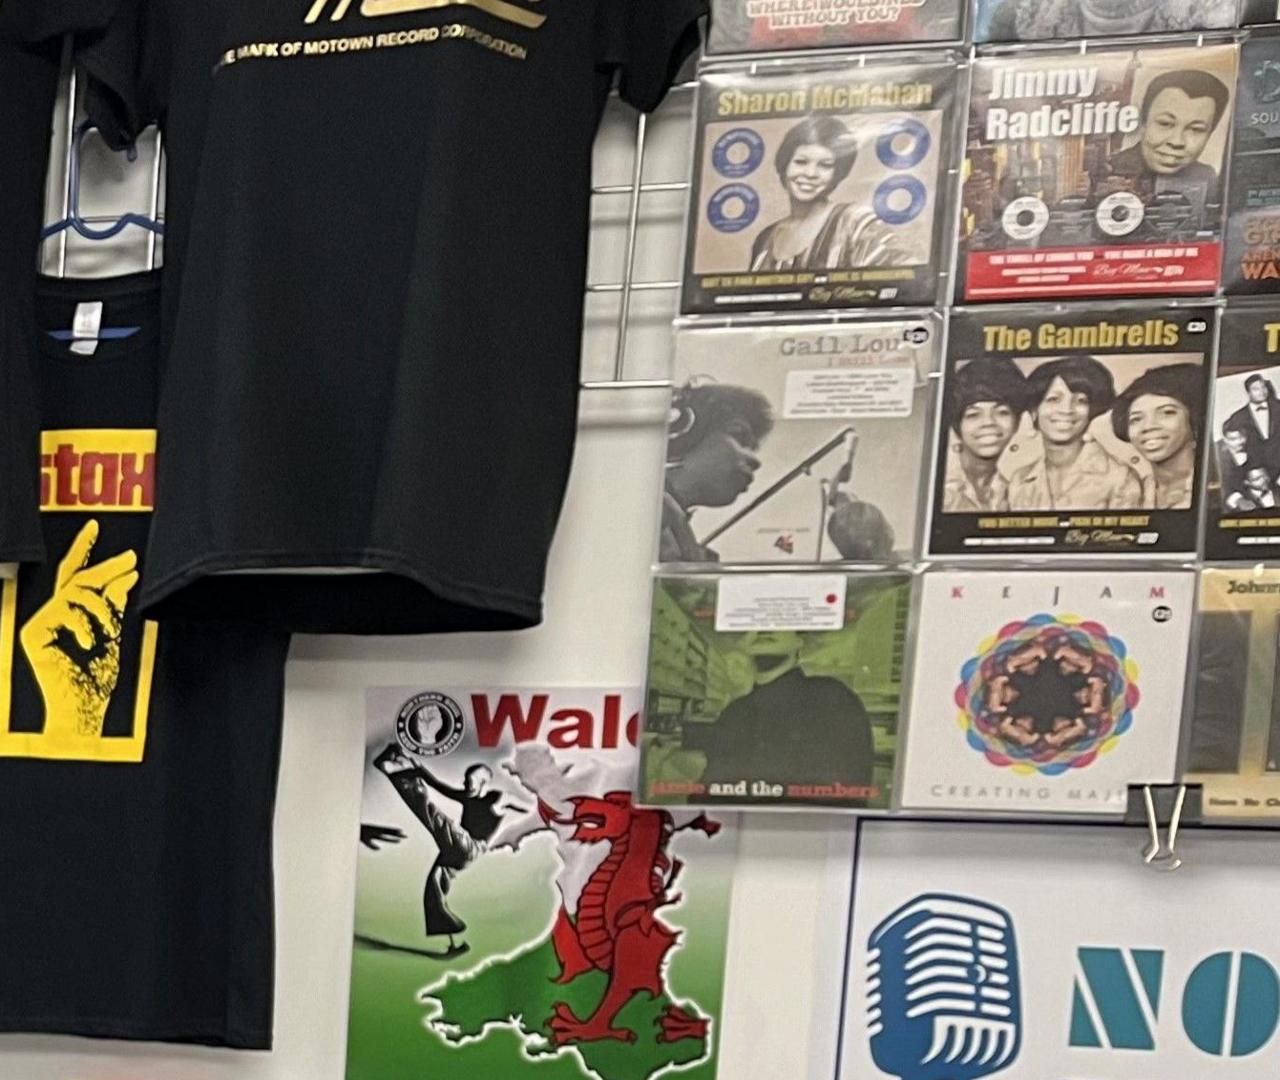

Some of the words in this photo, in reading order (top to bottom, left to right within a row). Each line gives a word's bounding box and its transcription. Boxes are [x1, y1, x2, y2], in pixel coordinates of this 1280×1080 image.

[281, 42, 302, 57] OF
[304, 36, 374, 55] MOTOWN
[376, 27, 439, 47] RECORD
[989, 67, 1098, 99] Jimmy
[718, 90, 807, 116] Sharon
[986, 101, 1140, 140] Radcliffe
[780, 335, 842, 357] Gail
[983, 326, 1031, 351] The
[1038, 320, 1179, 349] Gambrells
[709, 780, 747, 797] and
[751, 780, 783, 797] the
[930, 784, 1052, 800] CREATING
